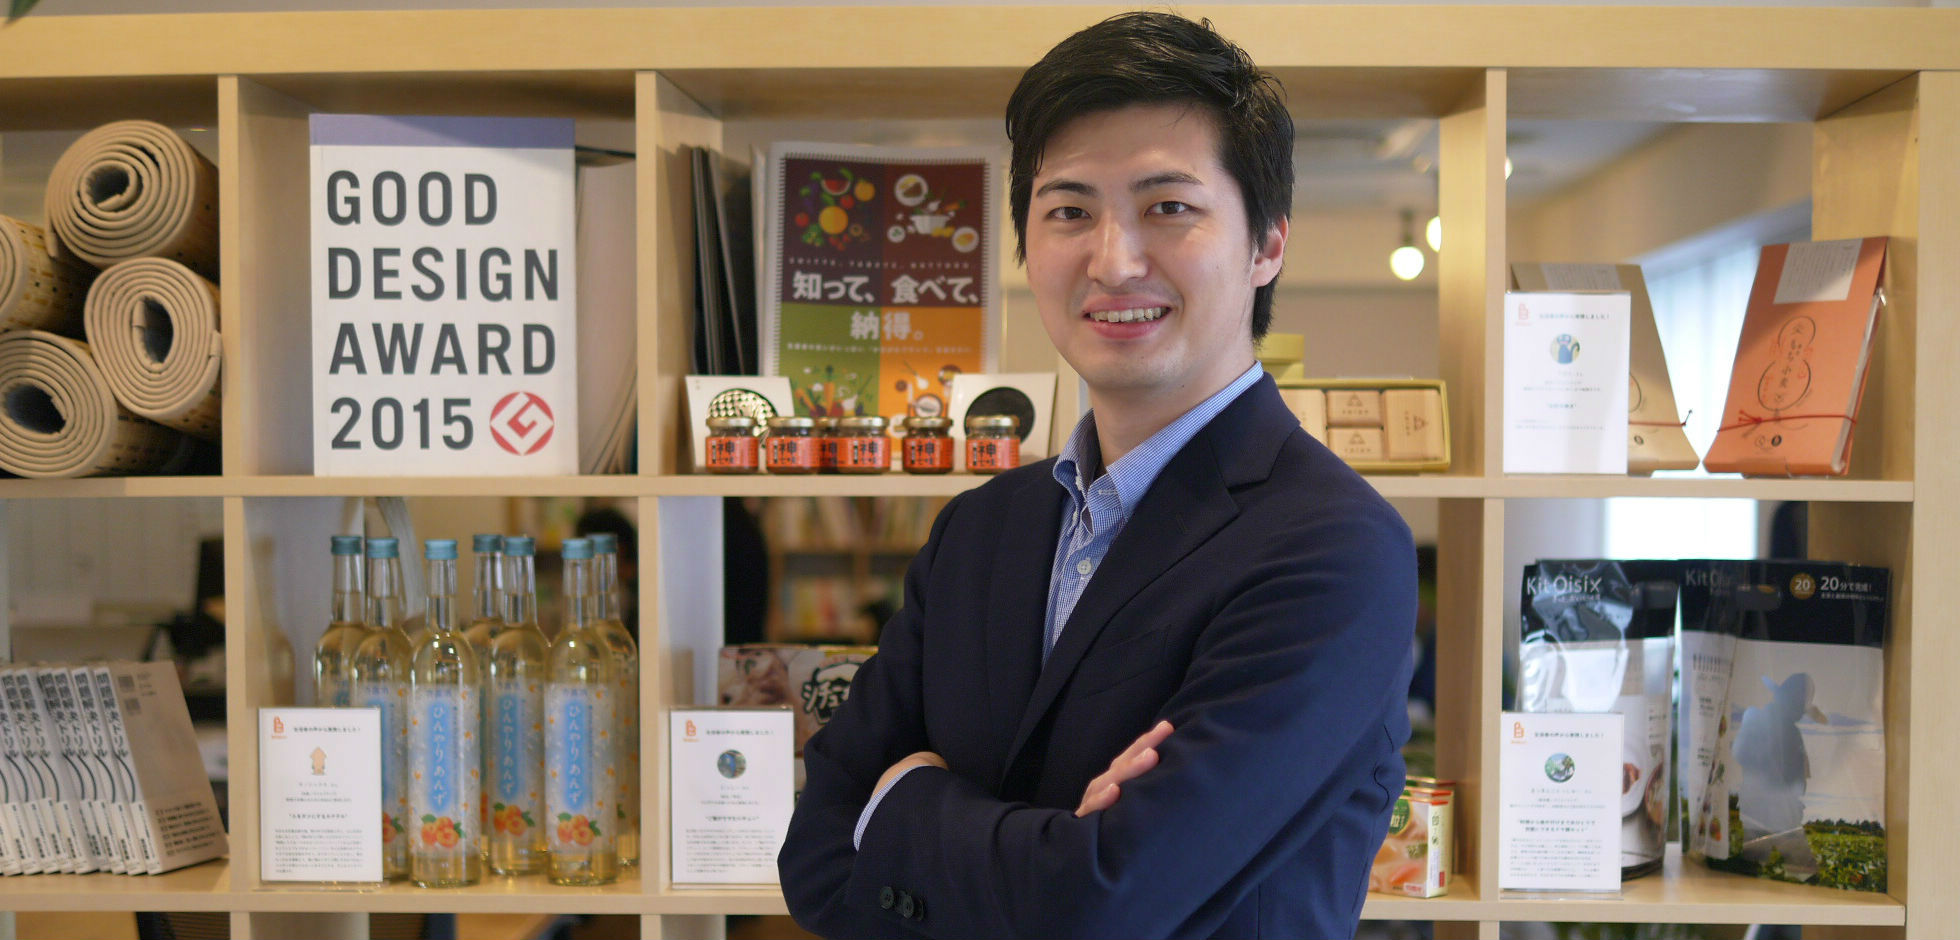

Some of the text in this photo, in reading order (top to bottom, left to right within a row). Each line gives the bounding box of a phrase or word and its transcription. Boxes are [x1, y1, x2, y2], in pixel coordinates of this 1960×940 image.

[327, 170, 497, 226] GOOD
[327, 246, 558, 302] DESIGN
[793, 270, 979, 303] 知って、 食べて、
[850, 311, 923, 340] 納得。
[328, 322, 556, 376] AWARD
[330, 397, 474, 451] 2015
[1527, 575, 1602, 595] Kit Oisix
[1686, 570, 1707, 586] Kit
[1796, 579, 1810, 591] 20
[802, 681, 850, 713] シチュ
[433, 704, 447, 806] ひんやりあんず
[569, 704, 582, 804] ひんやりあんず
